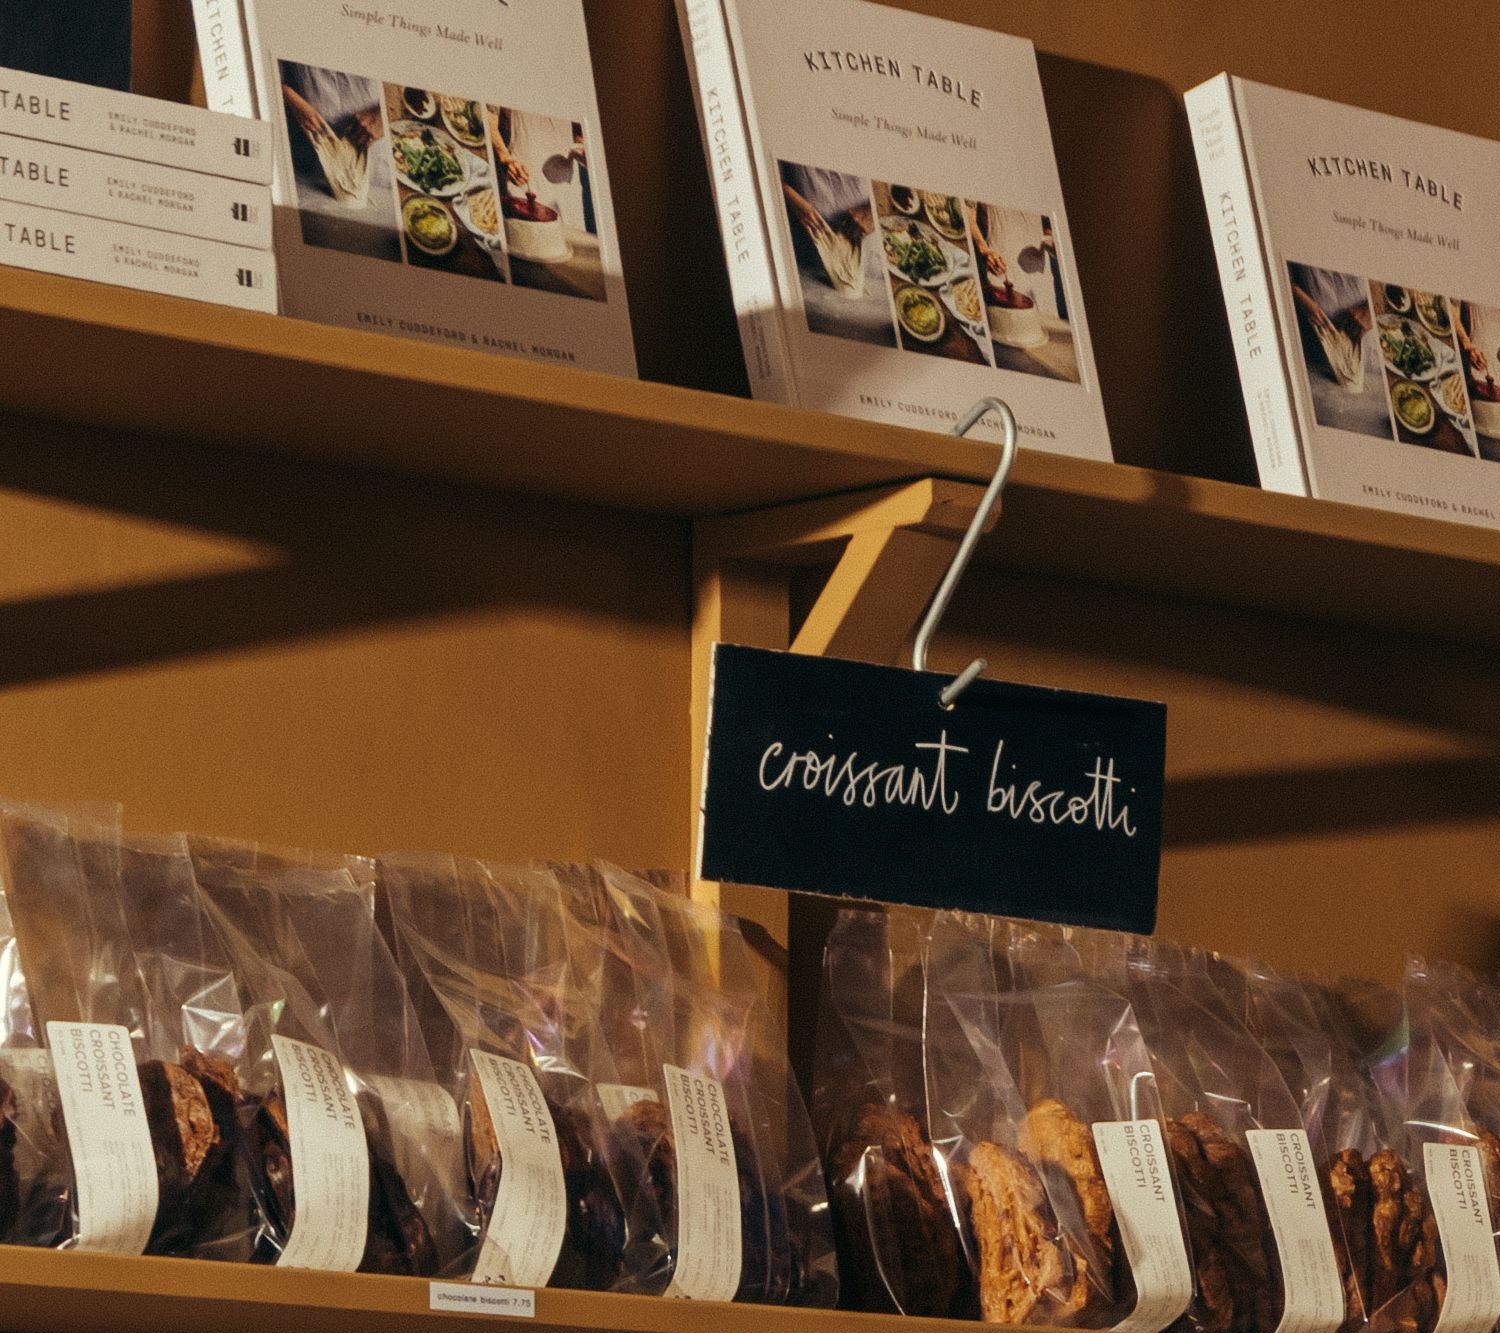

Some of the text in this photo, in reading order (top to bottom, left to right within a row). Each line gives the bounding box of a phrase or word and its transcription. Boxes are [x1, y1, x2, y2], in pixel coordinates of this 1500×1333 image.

[206, 0, 230, 81] ITCHEN
[340, 3, 505, 51] Simple Things Made Well
[0, 89, 71, 121] TABLE
[108, 111, 135, 127] EMILY
[803, 51, 983, 109] KITCHEN TABLE
[160, 132, 196, 147] MORGAN
[831, 107, 978, 150] Simple Things Made Well
[706, 87, 750, 265] KITCHEN TABLE
[1307, 156, 1464, 211] KITCHEN TABLE
[4, 223, 76, 254] TABLE
[1331, 210, 1460, 251] Simple Things Made Well
[1219, 191, 1262, 359] KITCHEN TABLE
[356, 311, 395, 329] EMILY
[482, 335, 526, 353] RACHEL
[531, 344, 576, 362] MORGAN
[859, 394, 893, 409] EMILY
[759, 728, 1137, 838] croissant biscotti
[70, 1028, 93, 1093] BISCOTTI
[89, 1029, 115, 1110] CROISSANT
[108, 1030, 136, 1117] CHOCOLATE
[291, 1045, 317, 1103] BISCOTTI
[307, 1048, 337, 1121] CROISSANT
[321, 1051, 355, 1130] CHOCOLATE
[488, 1058, 515, 1116] BISCOTTI
[502, 1061, 535, 1134] CROISSANT
[516, 1065, 551, 1144] CHOCOLATE
[679, 1074, 699, 1136] BISCOTTI
[693, 1079, 715, 1155] CROISSANT
[707, 1083, 729, 1167] CHOCOLATE
[1124, 1124, 1147, 1189] BISCOTTI
[1139, 1123, 1166, 1203] CROISSANT
[1276, 1132, 1298, 1194] BISCOTTI
[1290, 1132, 1316, 1209] CROISSANT
[1449, 1148, 1467, 1210] BISCOTTI
[1461, 1149, 1483, 1225] CROISSANT
